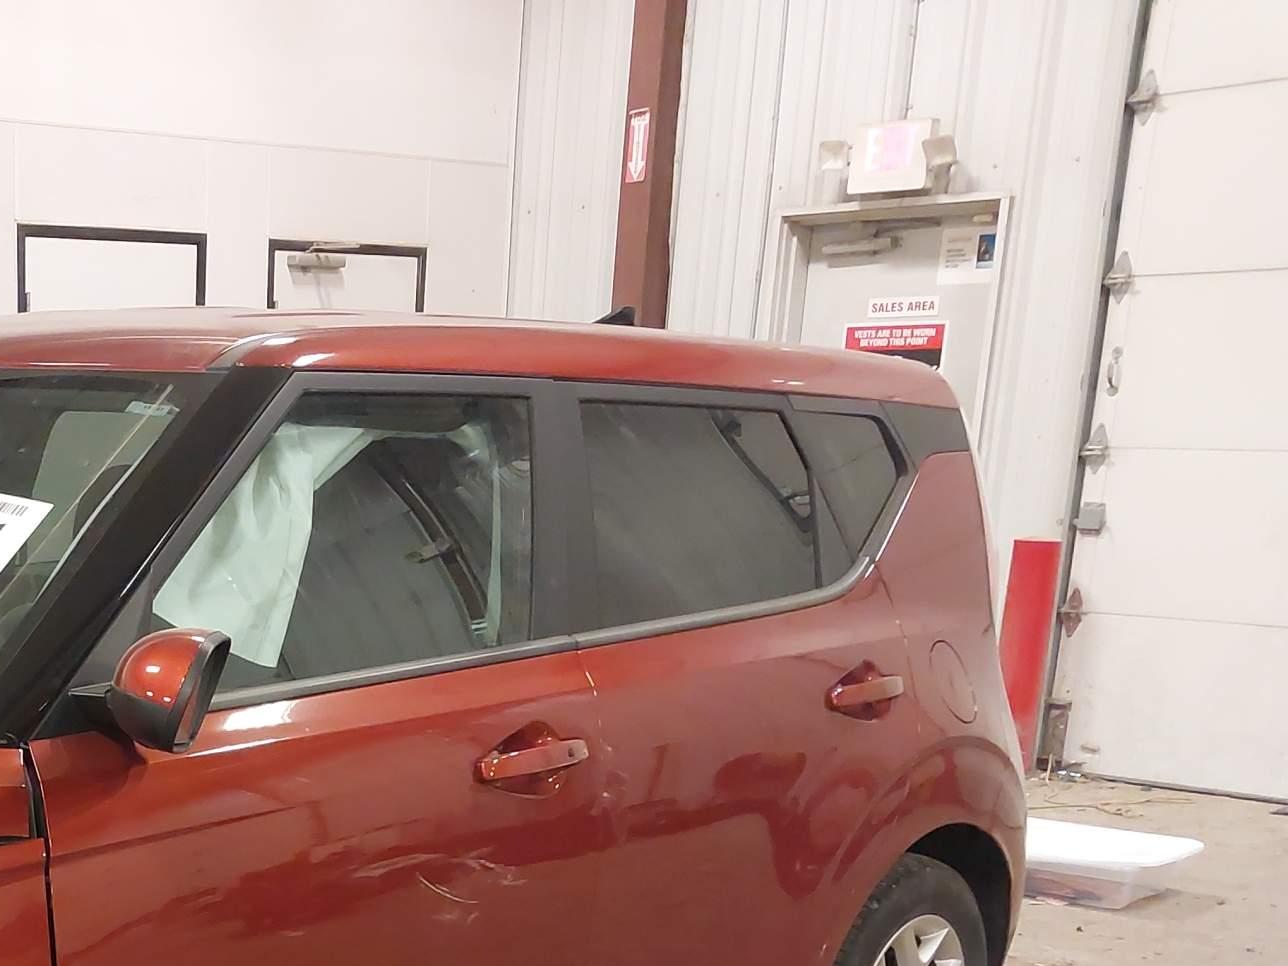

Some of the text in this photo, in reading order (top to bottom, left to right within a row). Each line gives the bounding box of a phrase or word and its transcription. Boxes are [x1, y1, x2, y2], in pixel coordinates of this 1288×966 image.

[871, 300, 935, 313] SALES AREA
[854, 330, 876, 338] VESTS
[876, 329, 890, 338] ARE
[892, 329, 902, 337] TO
[913, 328, 936, 337] WORN
[859, 337, 928, 347] BEYOND THIS POINT
